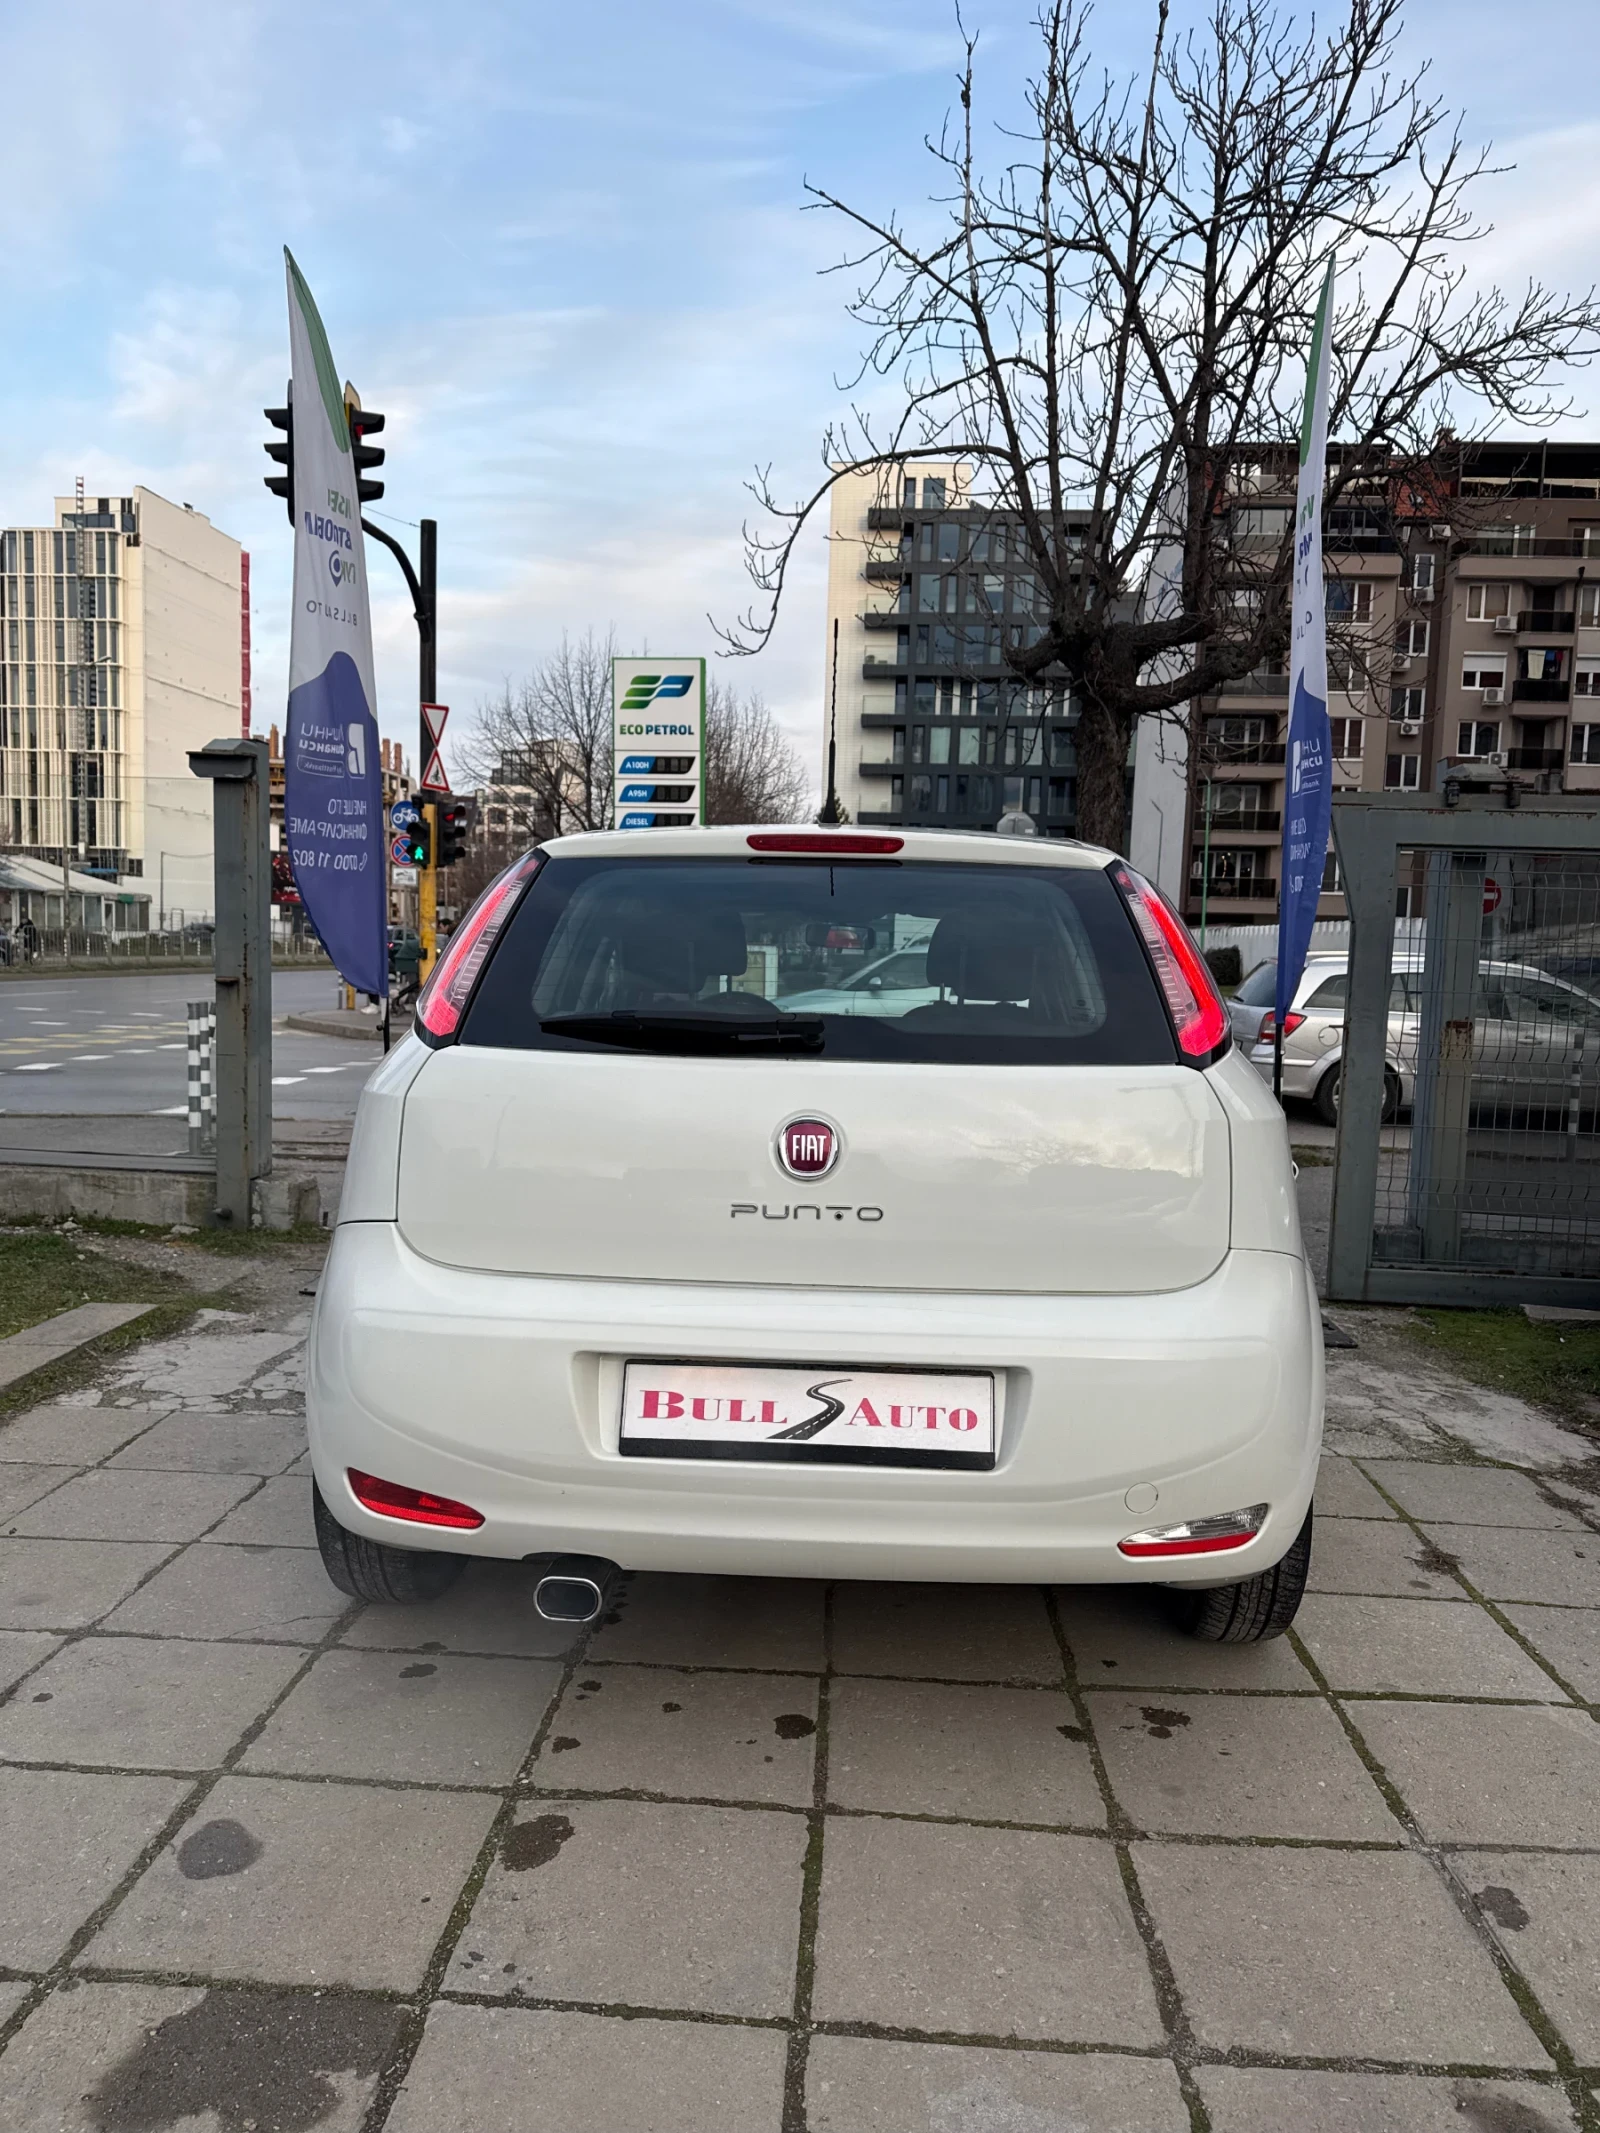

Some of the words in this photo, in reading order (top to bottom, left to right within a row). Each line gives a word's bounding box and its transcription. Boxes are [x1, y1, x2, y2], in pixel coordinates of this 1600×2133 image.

[625, 818, 649, 826] DIESEL
[792, 1134, 827, 1162] FIAT
[731, 1203, 884, 1222] PUNTO
